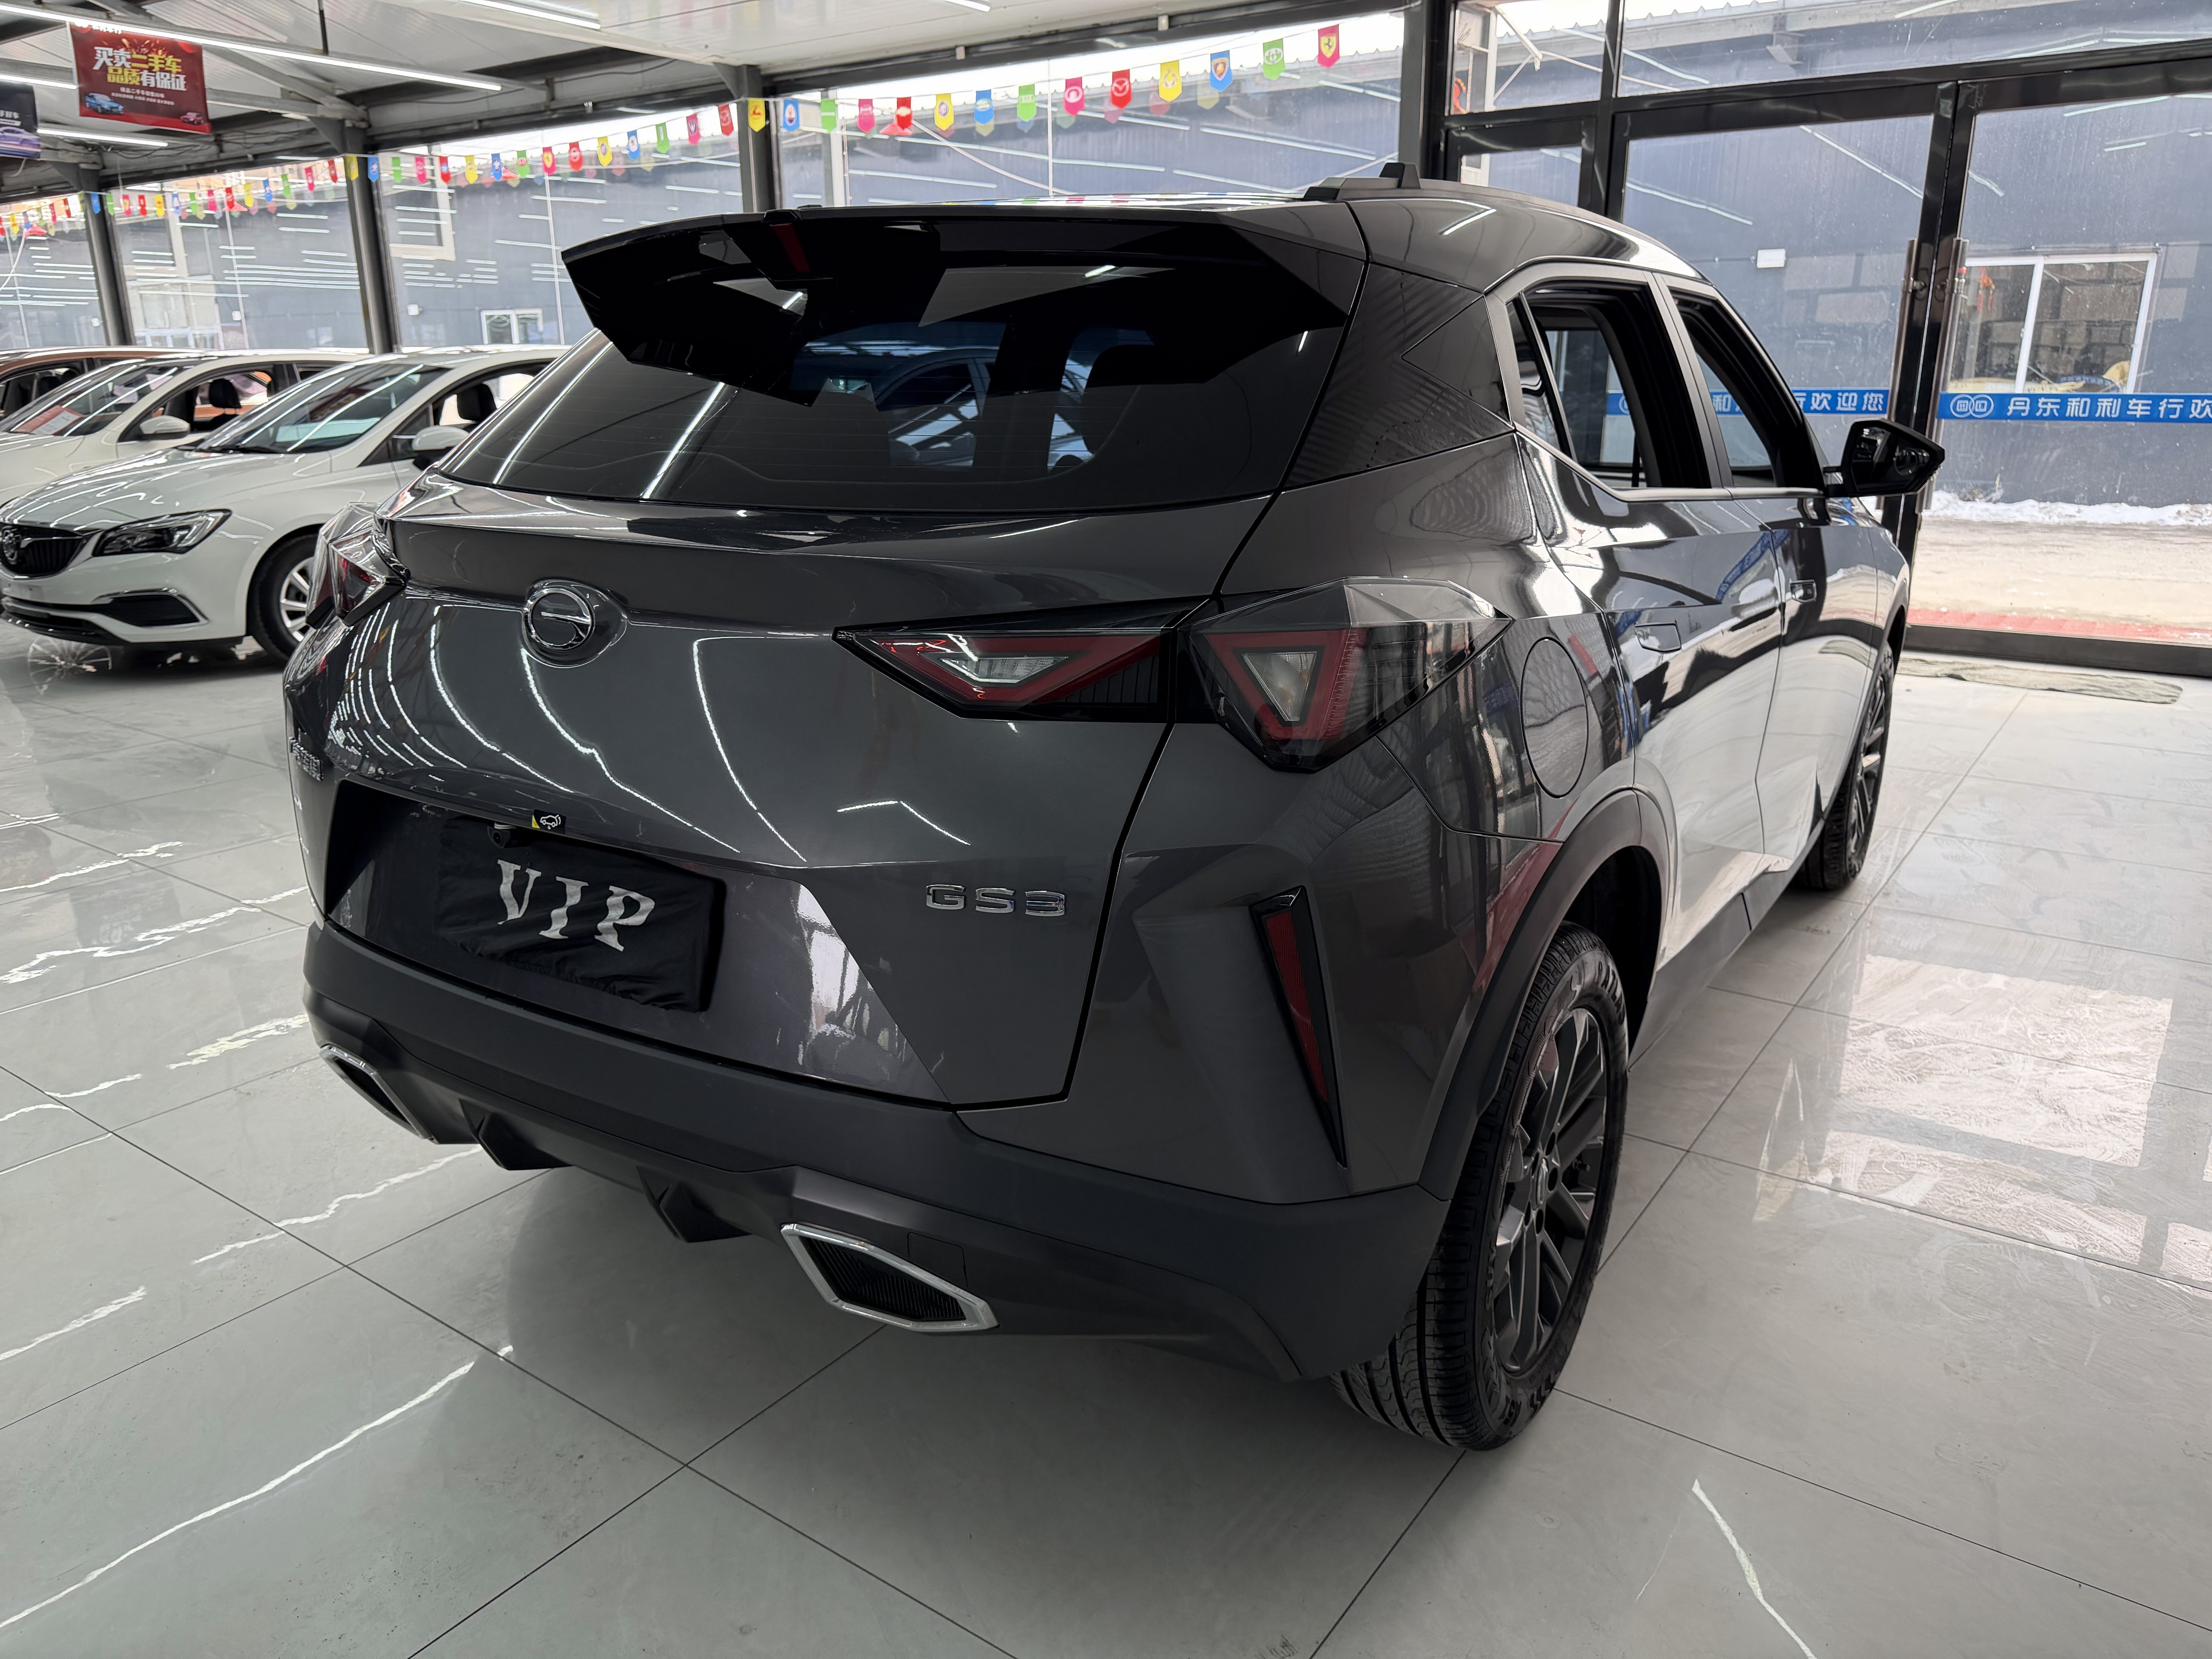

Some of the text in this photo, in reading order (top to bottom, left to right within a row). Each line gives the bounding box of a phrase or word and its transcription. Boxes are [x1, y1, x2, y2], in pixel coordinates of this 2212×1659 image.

[93, 46, 182, 74] 买卖二手车
[107, 66, 187, 91] 品质有保证
[2006, 397, 2212, 419] 丹东和利车行欢
[496, 859, 656, 952] VIP
[926, 884, 1066, 917] GS3
